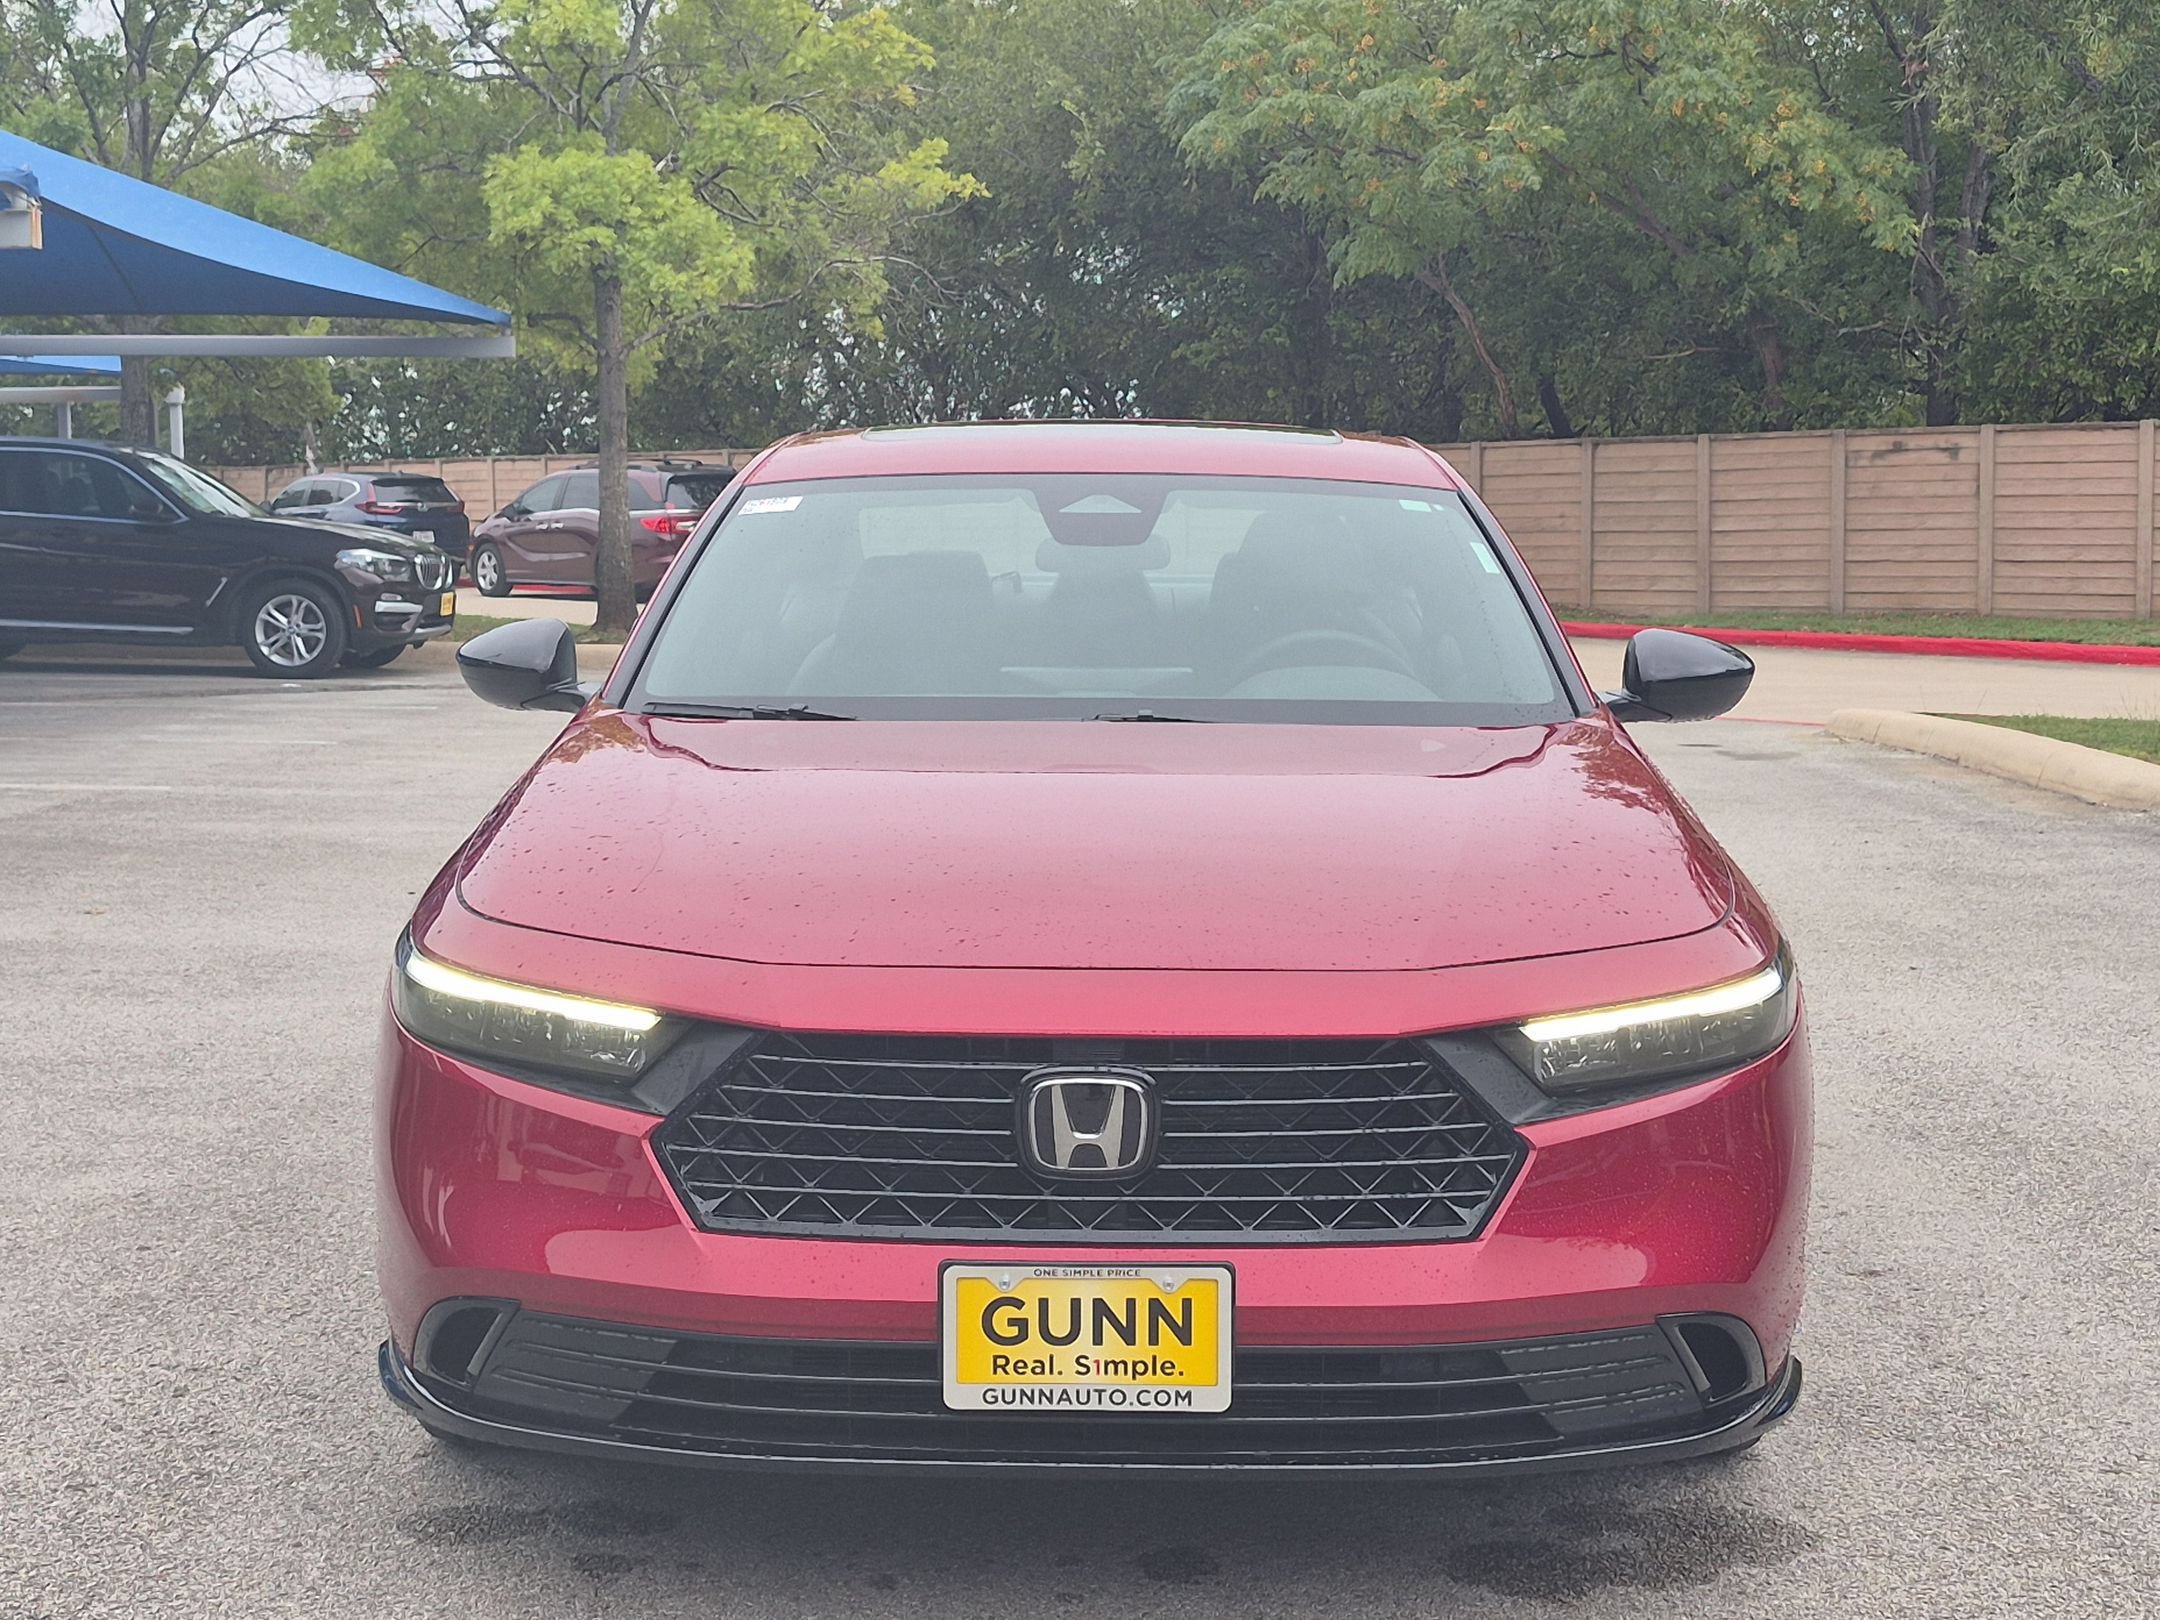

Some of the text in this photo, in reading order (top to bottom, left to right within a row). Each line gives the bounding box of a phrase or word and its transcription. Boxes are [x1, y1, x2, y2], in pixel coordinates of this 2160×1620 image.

[1033, 1268, 1141, 1277] ONE SIMPLE PRICE
[981, 1296, 1193, 1346] GUNN
[992, 1354, 1063, 1376] Real.
[982, 1388, 1193, 1407] GUNNAUTO.COM
